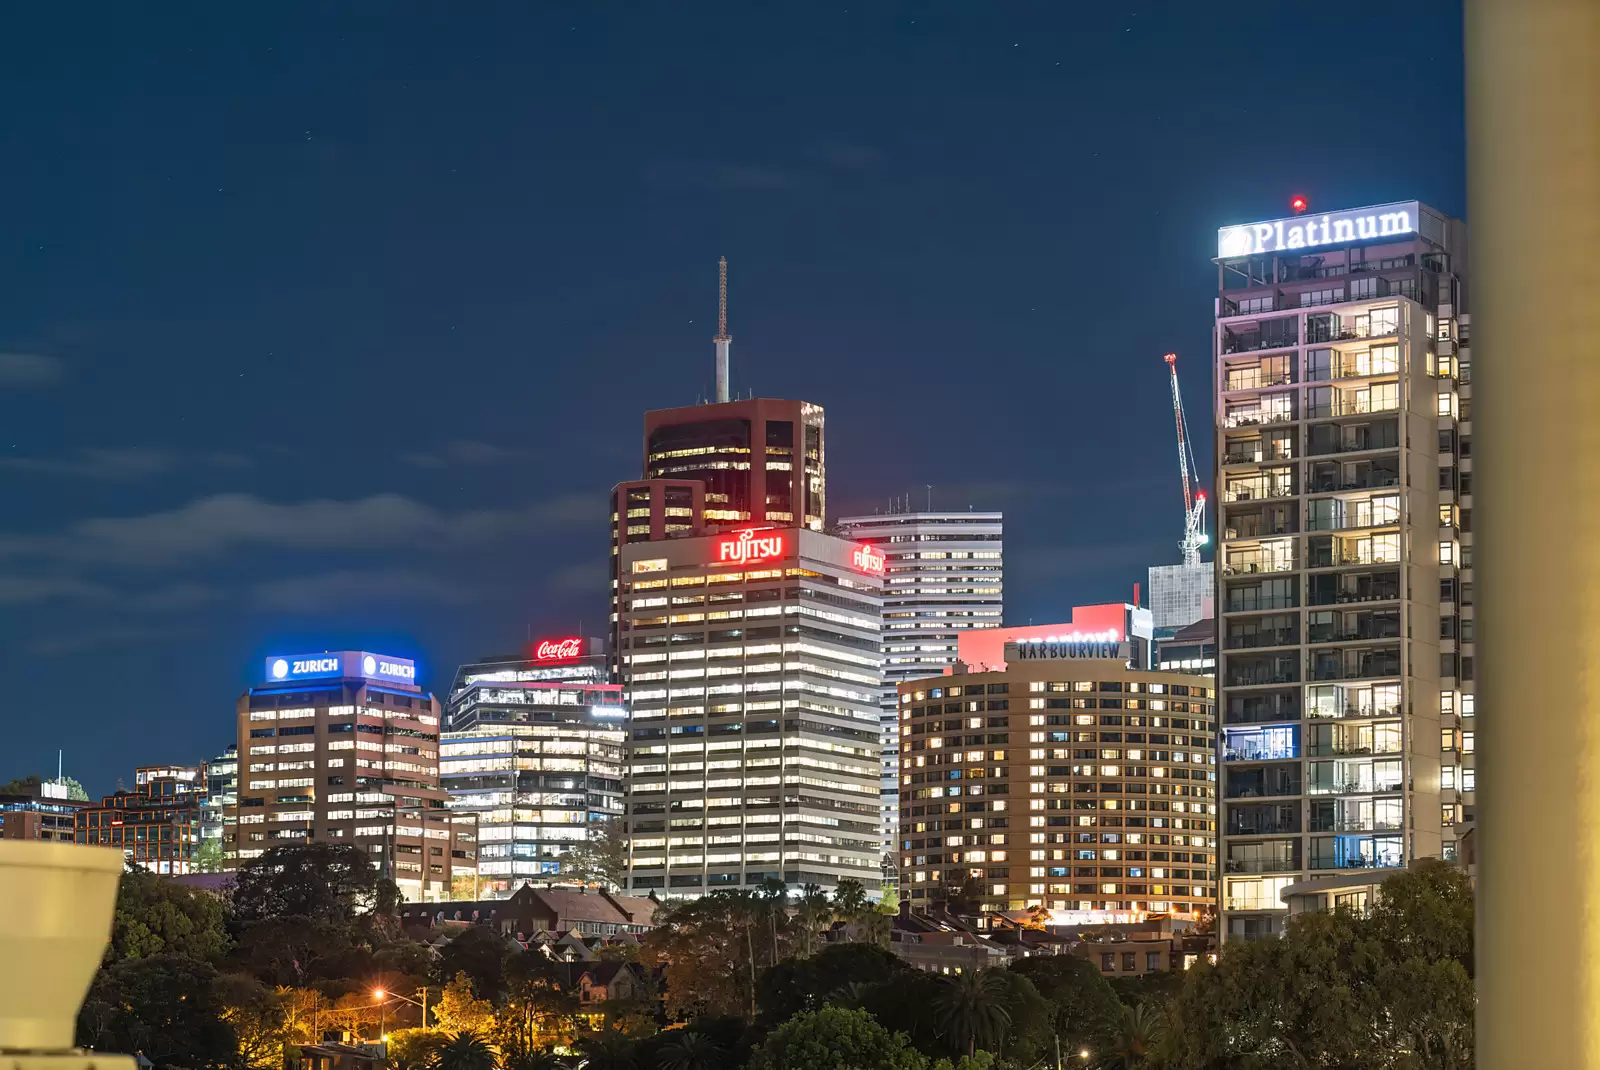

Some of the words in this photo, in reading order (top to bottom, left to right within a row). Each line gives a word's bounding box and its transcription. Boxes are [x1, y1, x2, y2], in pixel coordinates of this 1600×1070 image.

[1254, 210, 1412, 253] Platinum
[720, 529, 782, 564] FUJITSU
[853, 544, 883, 572] FUJITSU
[1018, 643, 1121, 660] HARBOURVIEW
[292, 658, 338, 674] ZURICH
[379, 661, 415, 678] ZURICH
